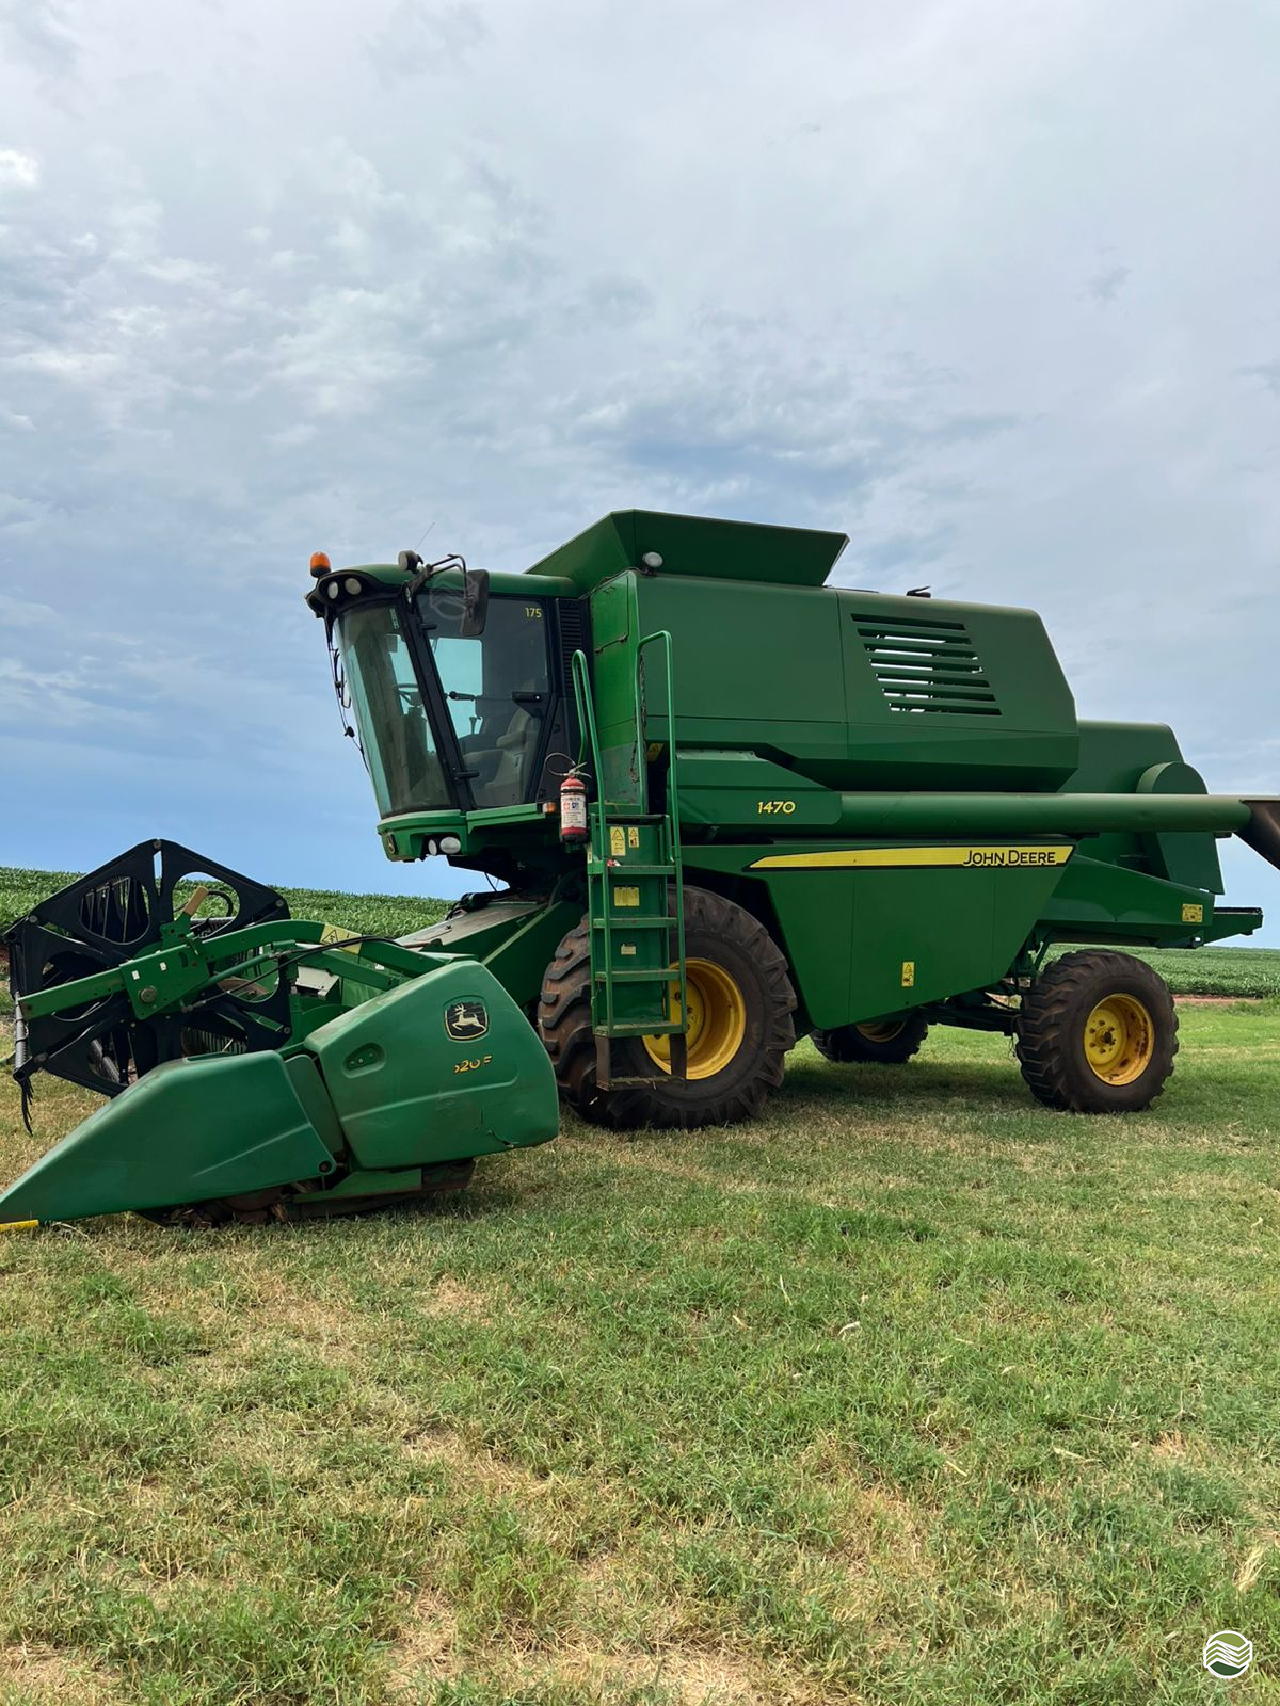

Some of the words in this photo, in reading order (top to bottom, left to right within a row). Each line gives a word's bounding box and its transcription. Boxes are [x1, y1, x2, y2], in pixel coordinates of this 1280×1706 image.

[757, 801, 796, 815] 1470
[963, 850, 1005, 866] JOHN
[1008, 850, 1056, 865] DEERE
